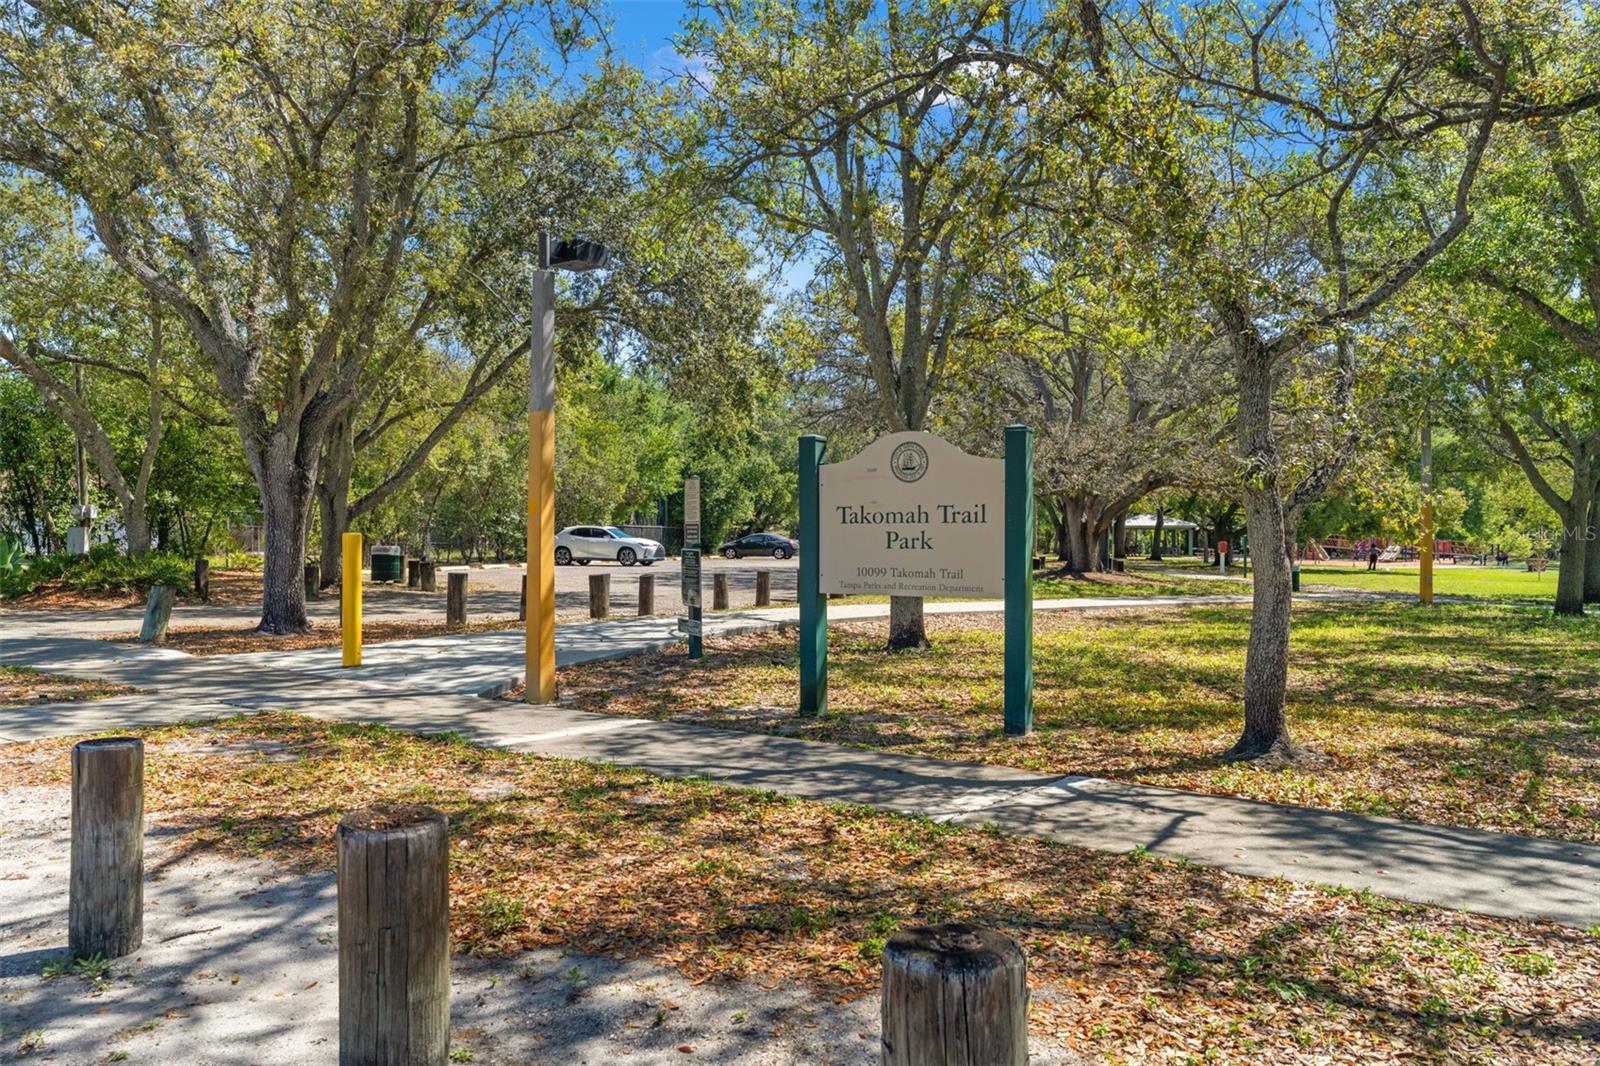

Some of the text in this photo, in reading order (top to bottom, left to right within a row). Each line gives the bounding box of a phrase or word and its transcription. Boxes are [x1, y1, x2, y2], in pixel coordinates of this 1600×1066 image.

[836, 503, 988, 525] Takomah Trail
[885, 530, 934, 550] Park
[856, 567, 964, 580] 10099 Takomah Trail
[838, 580, 984, 593] Tampa Parks and Recreation Department
